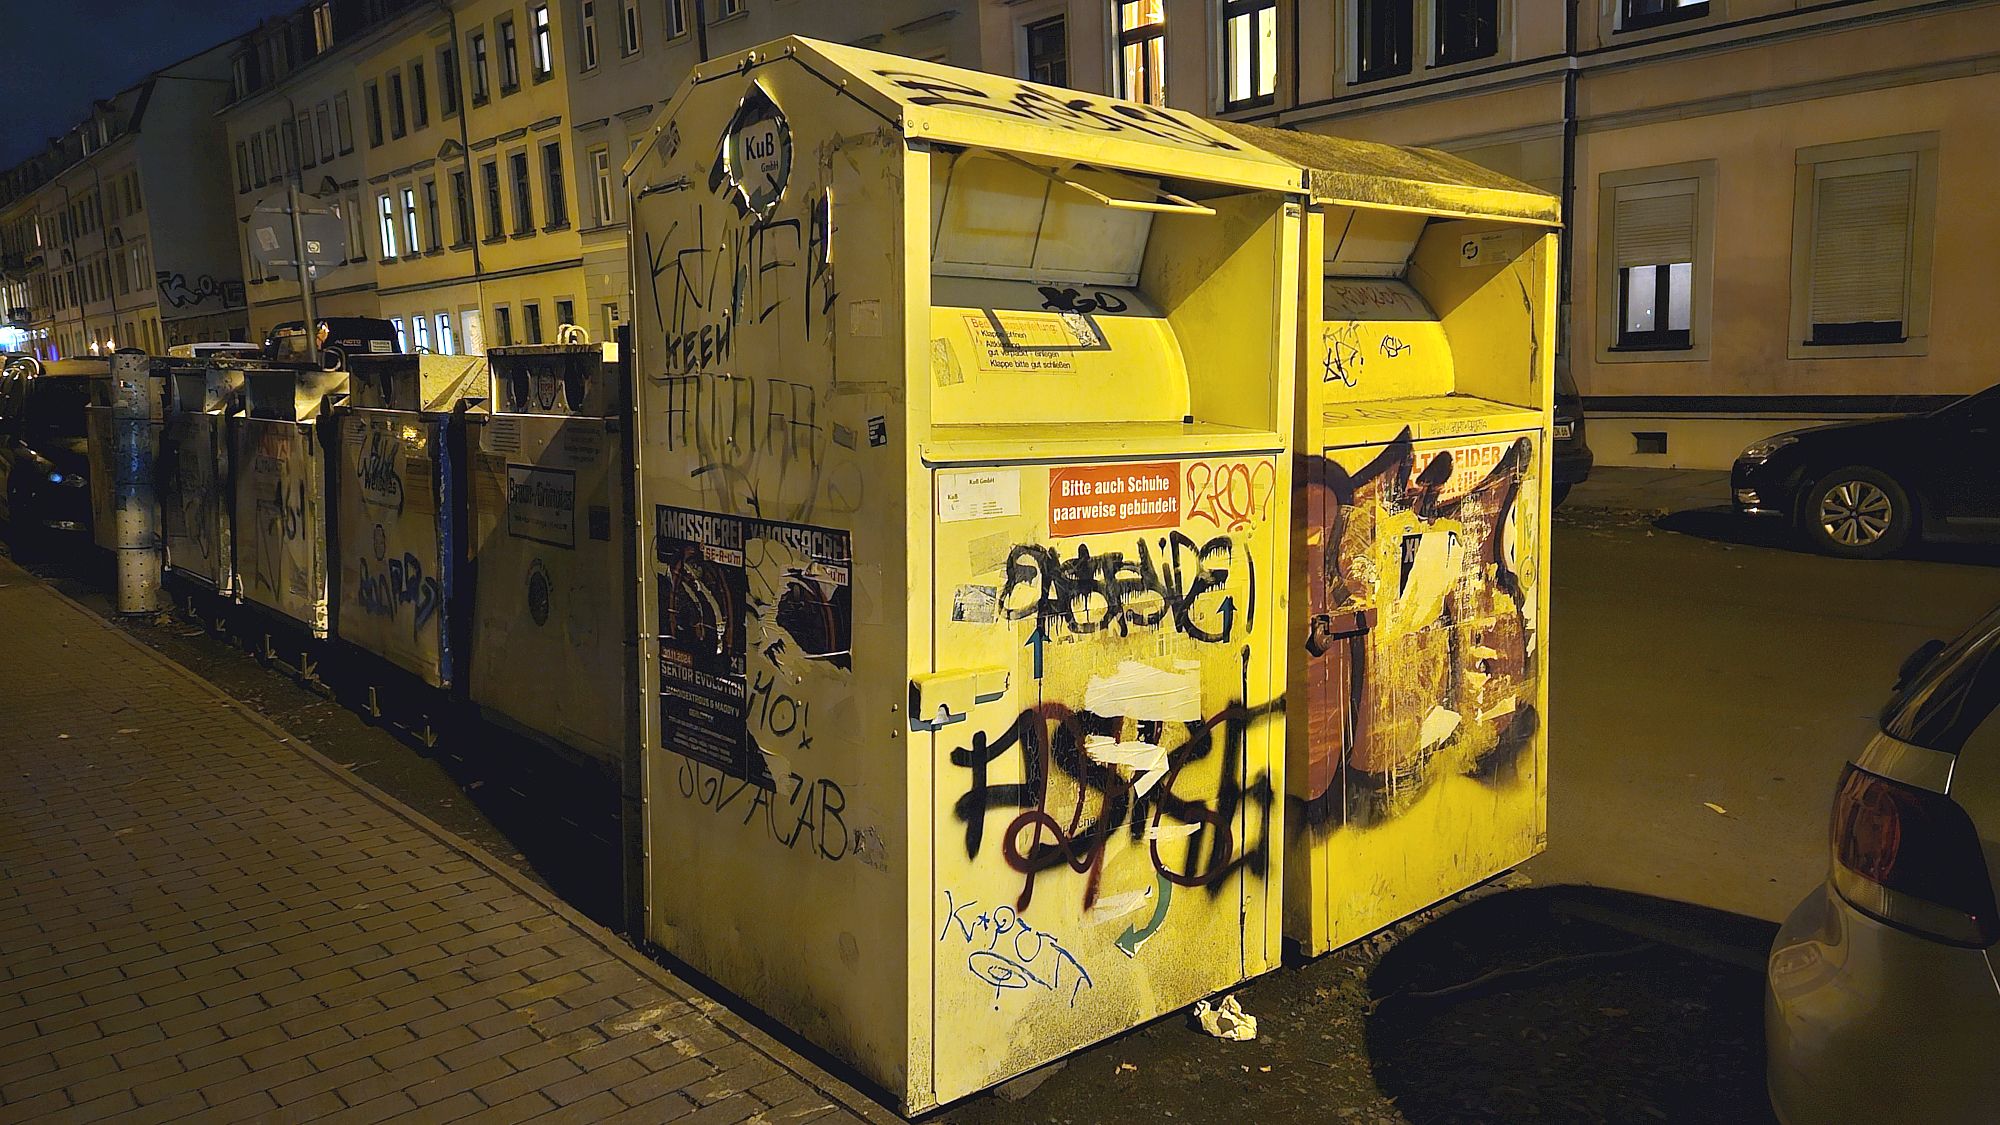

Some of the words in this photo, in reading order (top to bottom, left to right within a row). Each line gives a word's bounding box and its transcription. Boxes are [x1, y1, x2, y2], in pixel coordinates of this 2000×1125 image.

[745, 132, 774, 160] KuB
[761, 161, 779, 172] GmbH
[988, 350, 998, 358] gut
[989, 359, 1013, 369] Klappe
[1014, 360, 1029, 368] bitte
[1031, 361, 1041, 369] gut
[1043, 361, 1071, 369] schließen
[1061, 479, 1091, 497] Bitte
[1094, 475, 1125, 495] auch
[1127, 475, 1169, 492] Schuhe
[1053, 506, 1117, 525] paarweise
[1120, 497, 1177, 519] gebündelt
[661, 661, 694, 683] SEKTOR
[695, 669, 744, 699] EVOLUTION
